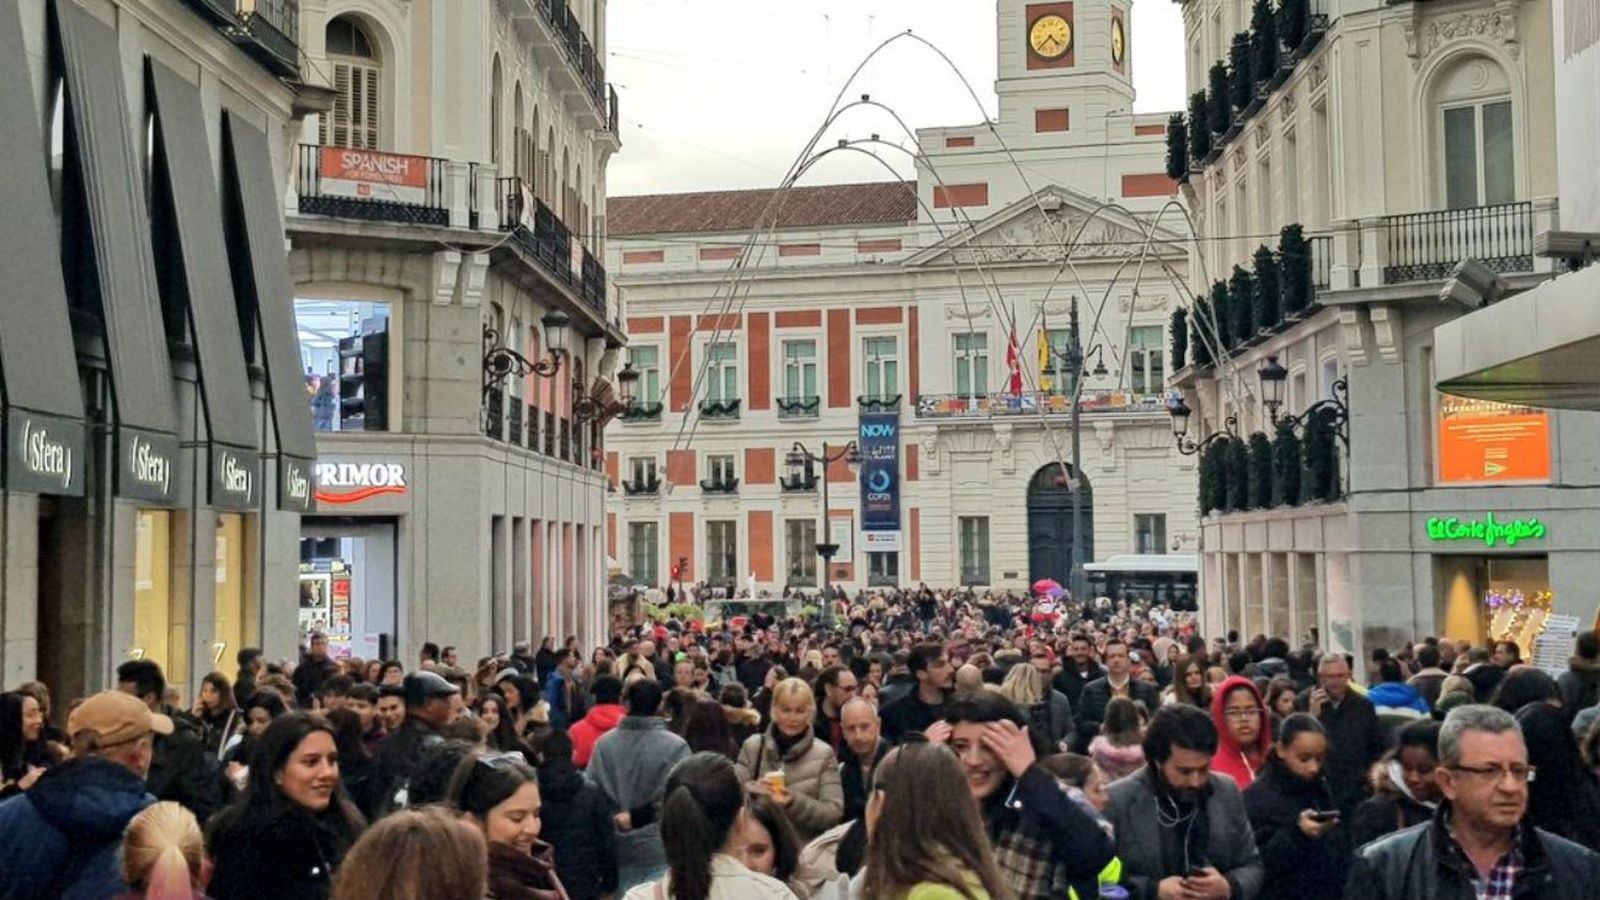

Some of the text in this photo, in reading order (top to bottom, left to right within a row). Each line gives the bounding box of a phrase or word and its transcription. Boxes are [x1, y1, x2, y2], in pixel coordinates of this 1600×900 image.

[341, 151, 408, 174] SPANISH
[861, 424, 895, 437] NOW
[1426, 517, 1445, 539] El
[1445, 517, 1485, 539] Corte
